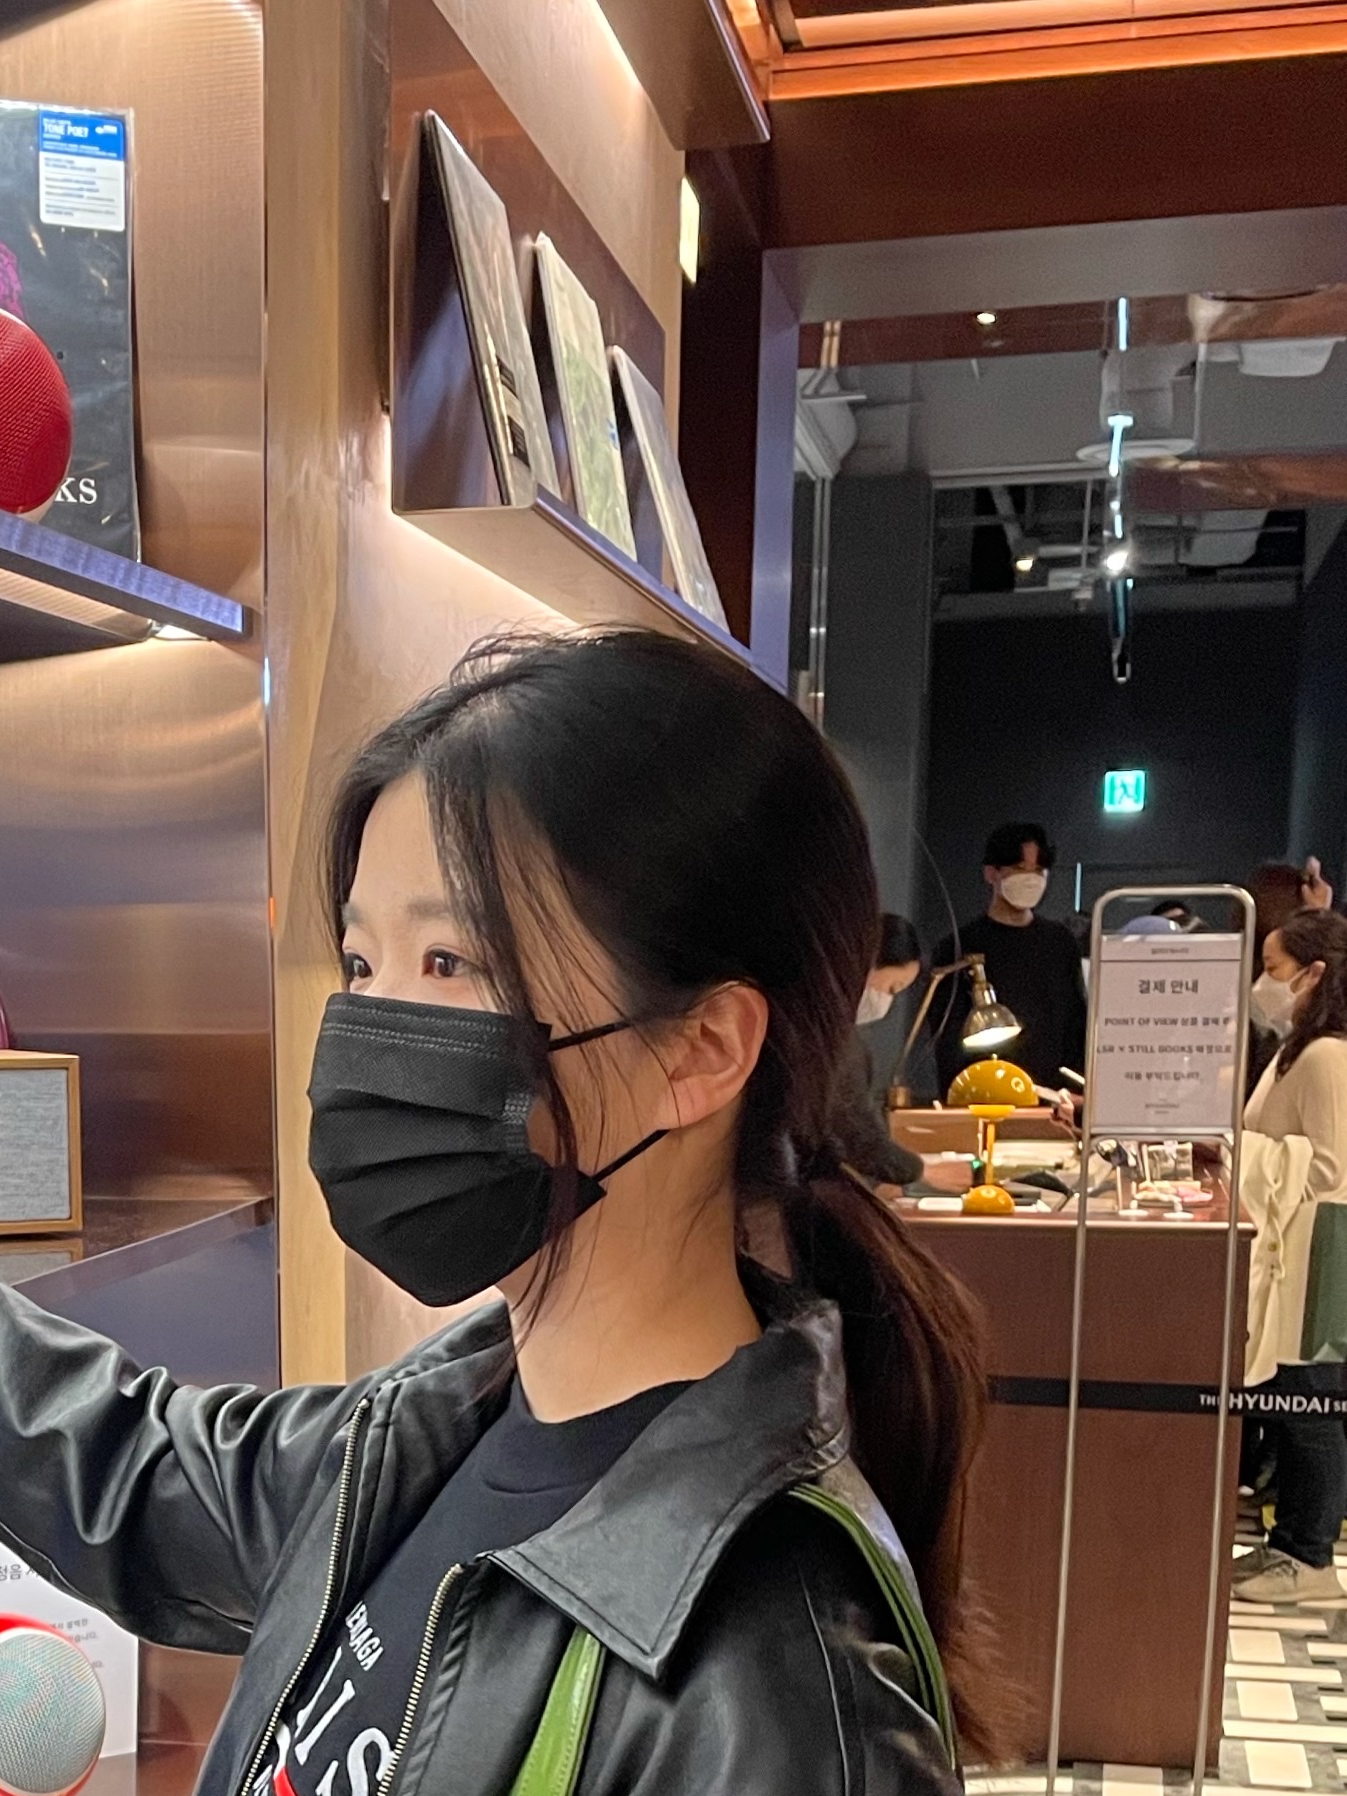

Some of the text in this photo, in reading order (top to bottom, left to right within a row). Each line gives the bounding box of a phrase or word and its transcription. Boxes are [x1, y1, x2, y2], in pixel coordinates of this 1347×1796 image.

[1138, 978, 1199, 994] 결제 안내
[1104, 1017, 1134, 1026] POINT
[1138, 1017, 1151, 1026] OF
[1153, 1017, 1179, 1026] VIEW
[1199, 1394, 1220, 1406] TH
[1228, 1393, 1330, 1413] HYUNDAI
